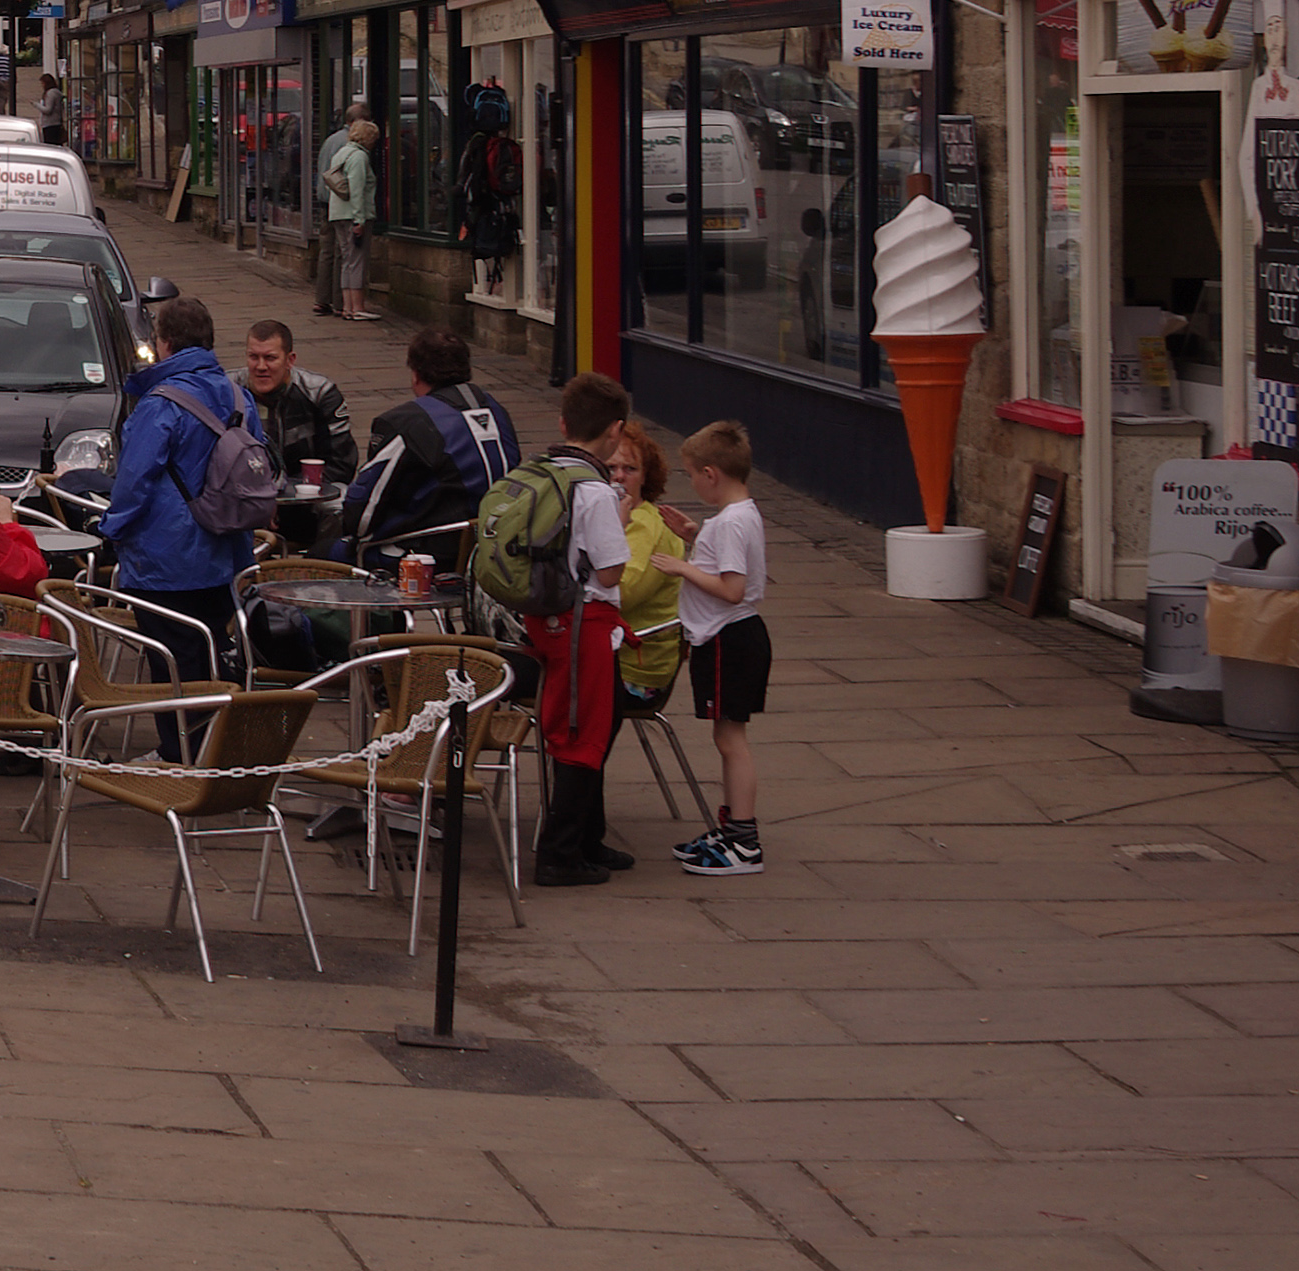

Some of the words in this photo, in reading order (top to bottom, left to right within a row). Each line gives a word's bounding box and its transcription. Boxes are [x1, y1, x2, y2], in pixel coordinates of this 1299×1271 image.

[861, 8, 913, 21] Luxury
[852, 19, 874, 30] Ice
[878, 20, 924, 32] Cream
[853, 46, 886, 58] Sold
[889, 48, 924, 60] Here
[37, 170, 59, 185] Ltd
[1266, 158, 1299, 190] PORK
[14, 190, 35, 199] Digital
[37, 191, 57, 199] Radio
[1, 197, 19, 205] Sales
[30, 199, 56, 207] Service
[1268, 291, 1299, 325] BEEF
[1174, 503, 1230, 517] Arabica
[1214, 520, 1253, 540] Rijo
[1162, 603, 1199, 629] rijo
